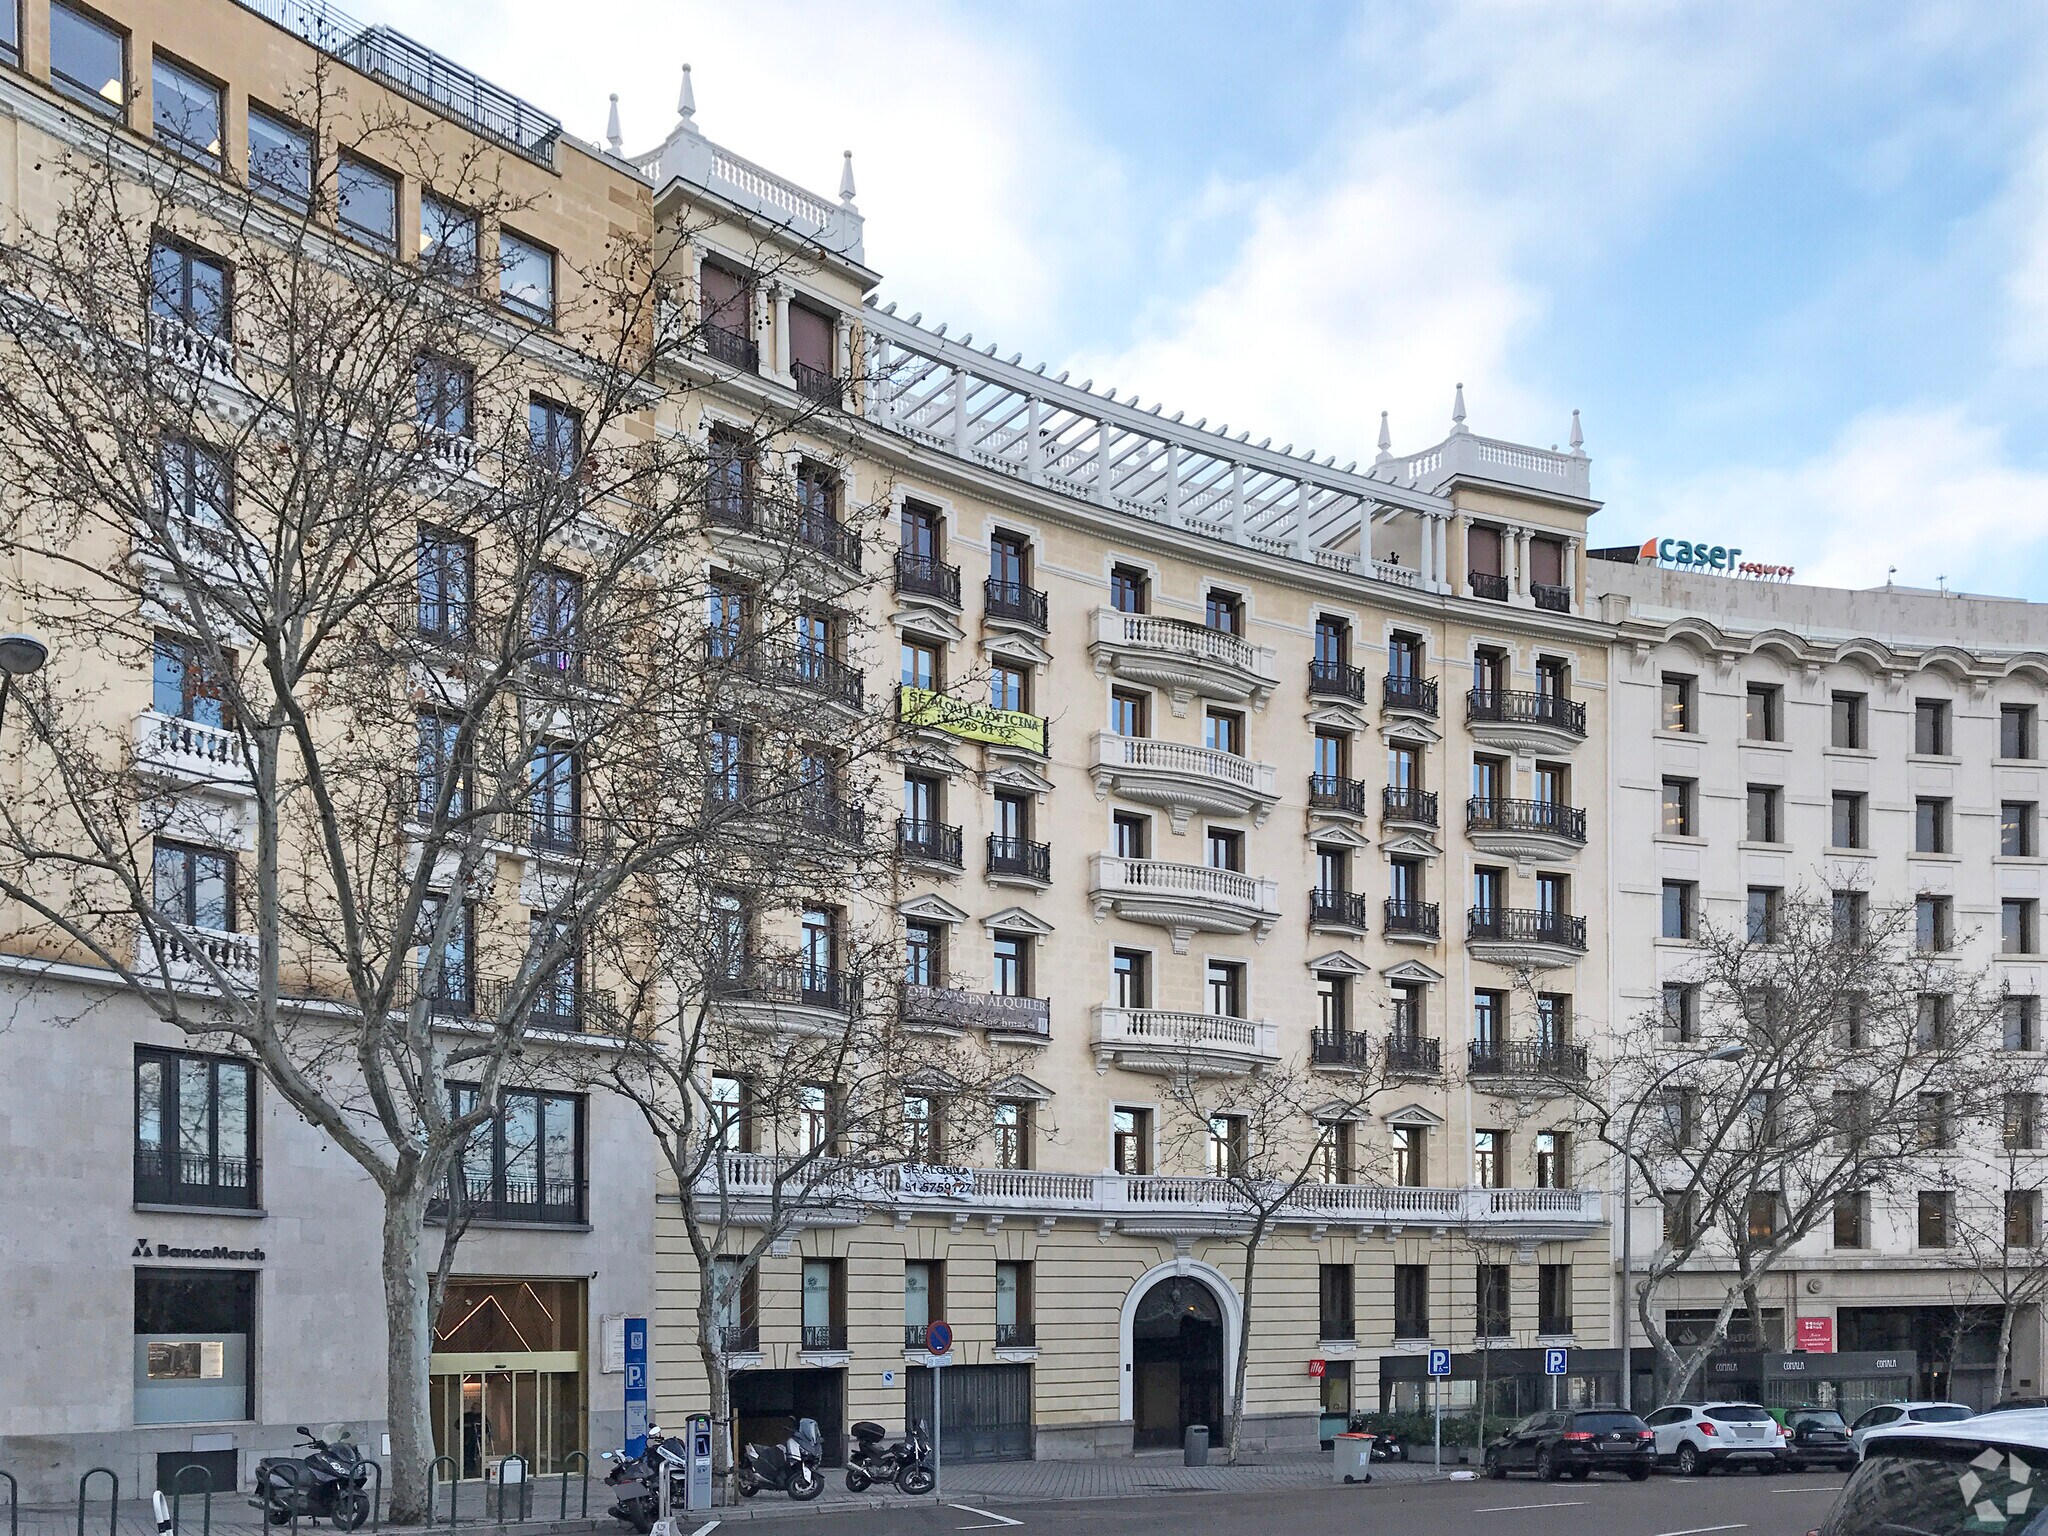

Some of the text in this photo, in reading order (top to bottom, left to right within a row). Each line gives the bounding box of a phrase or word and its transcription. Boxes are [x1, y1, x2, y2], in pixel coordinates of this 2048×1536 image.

[1659, 538, 1742, 570] caser
[1739, 561, 1795, 578] seguros
[909, 692, 926, 705] SE
[988, 711, 1039, 732] OFICINA
[969, 994, 985, 1005] EN
[988, 995, 1046, 1012] ALQUILER
[903, 1164, 970, 1176] SE ALQUILA
[905, 1182, 917, 1192] 91
[158, 1244, 266, 1261] BancaMarch
[1310, 1362, 1324, 1376] illy
[1433, 1352, 1446, 1371] P
[1551, 1352, 1563, 1371] P
[628, 1366, 641, 1386] P
